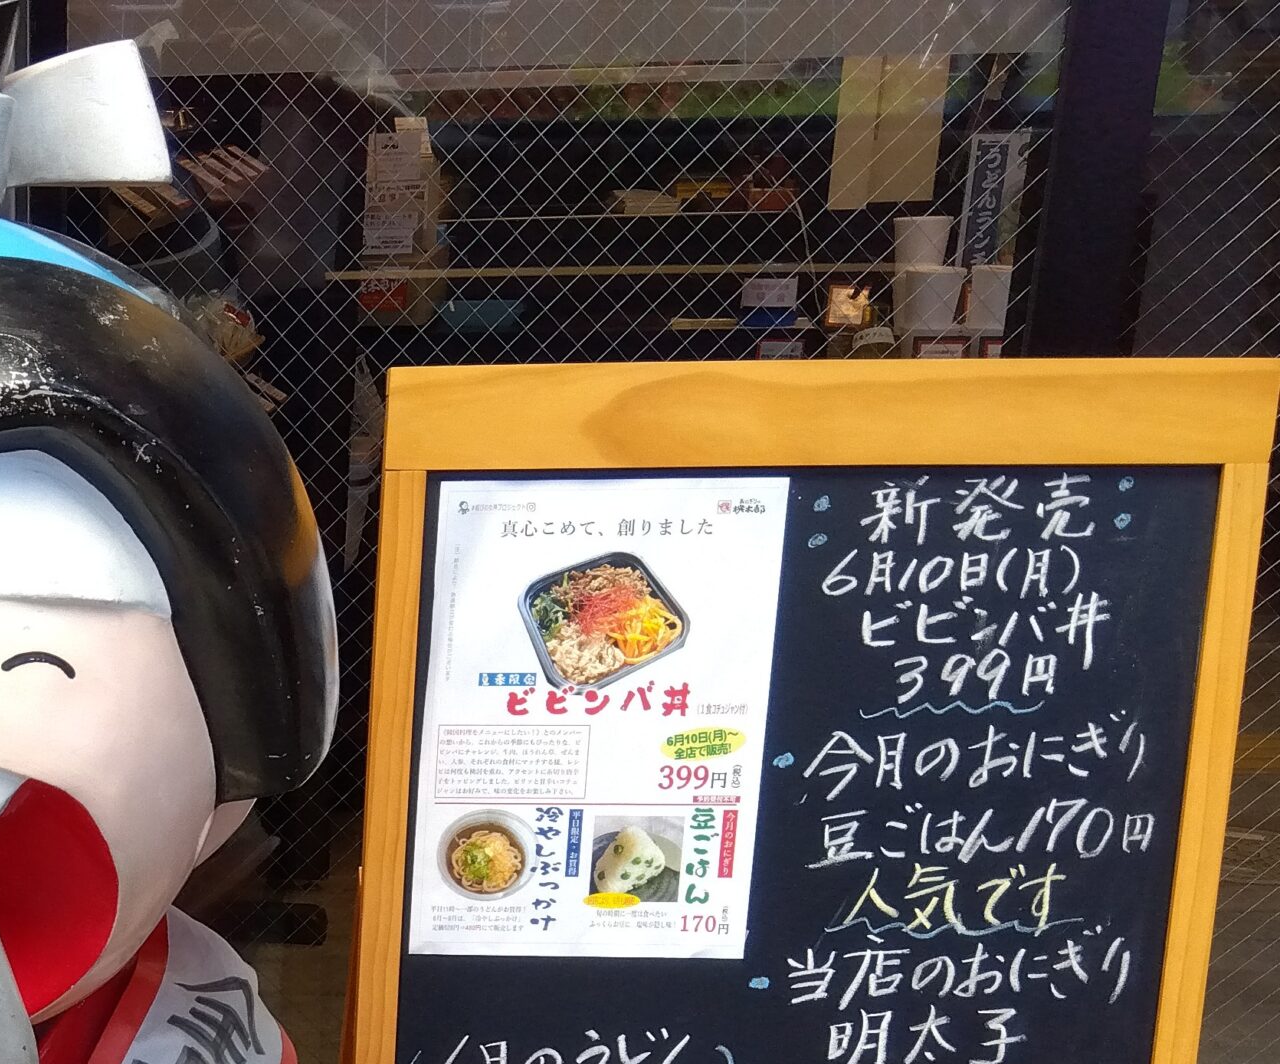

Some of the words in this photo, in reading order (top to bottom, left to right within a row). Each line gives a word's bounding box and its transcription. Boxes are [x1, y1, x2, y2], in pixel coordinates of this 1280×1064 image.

[501, 518, 714, 539] 真心こめて、創りました
[861, 473, 1096, 545] 新発売
[822, 545, 1080, 599] 6月10日(月)
[507, 682, 690, 717] ビビンバ丼
[894, 648, 1057, 703] 399円
[666, 729, 739, 747] 6月10日(月)～
[674, 743, 732, 760] 全店で販売!
[803, 710, 1145, 800] 今月のおにぎり
[658, 764, 727, 791] 399円
[731, 764, 743, 788] （税込）
[568, 811, 582, 876] 平日限定・お買得
[685, 807, 719, 904] 豆ごはん
[722, 812, 736, 876] 今月のおにぎり
[805, 799, 1155, 867] 豆ごはん170円
[530, 807, 564, 931] 冷やしぶっかけ
[843, 863, 1067, 936] 人気です
[680, 914, 730, 935] 170円
[787, 926, 1131, 1010] 当店のおにぎり
